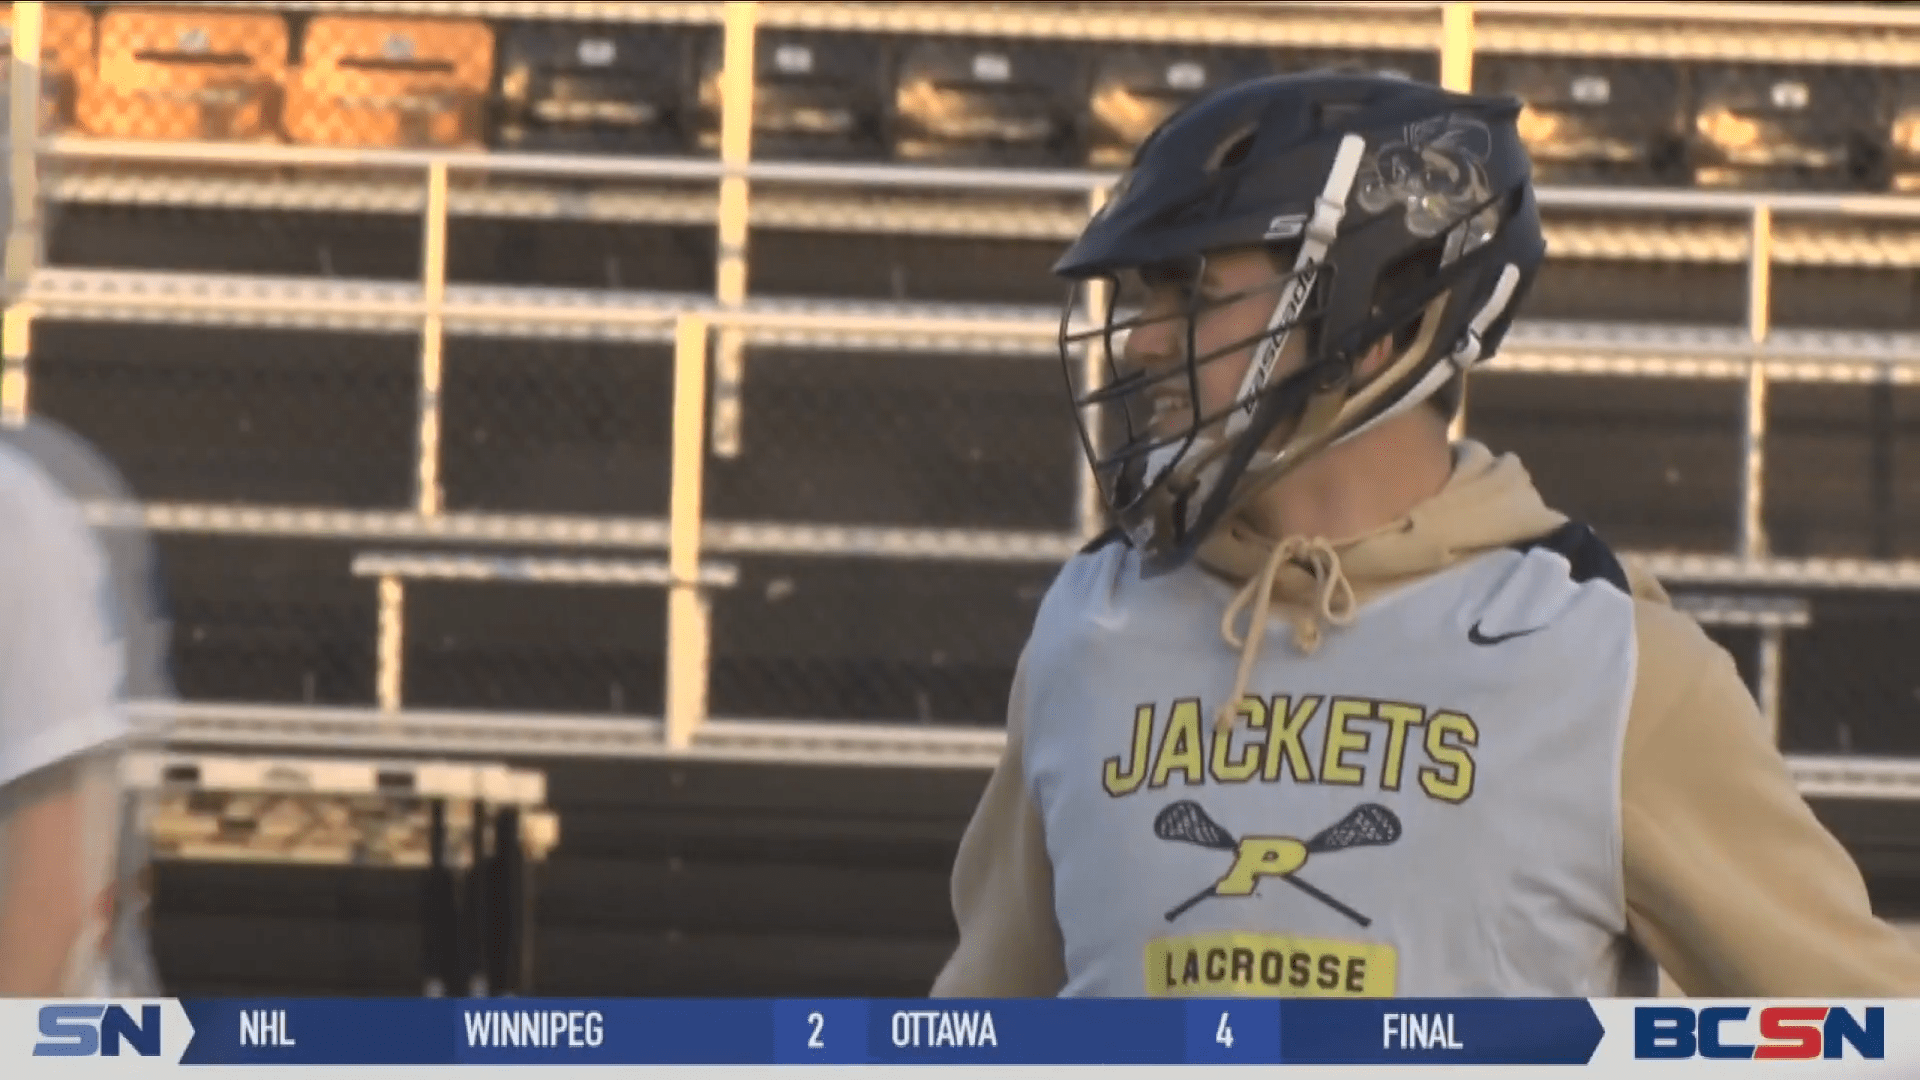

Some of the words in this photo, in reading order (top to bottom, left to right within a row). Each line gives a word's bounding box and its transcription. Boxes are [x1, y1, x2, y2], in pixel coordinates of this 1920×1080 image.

[1102, 694, 1480, 806] JACKETS
[1214, 834, 1310, 897] P
[1165, 947, 1367, 993] LACROSSE
